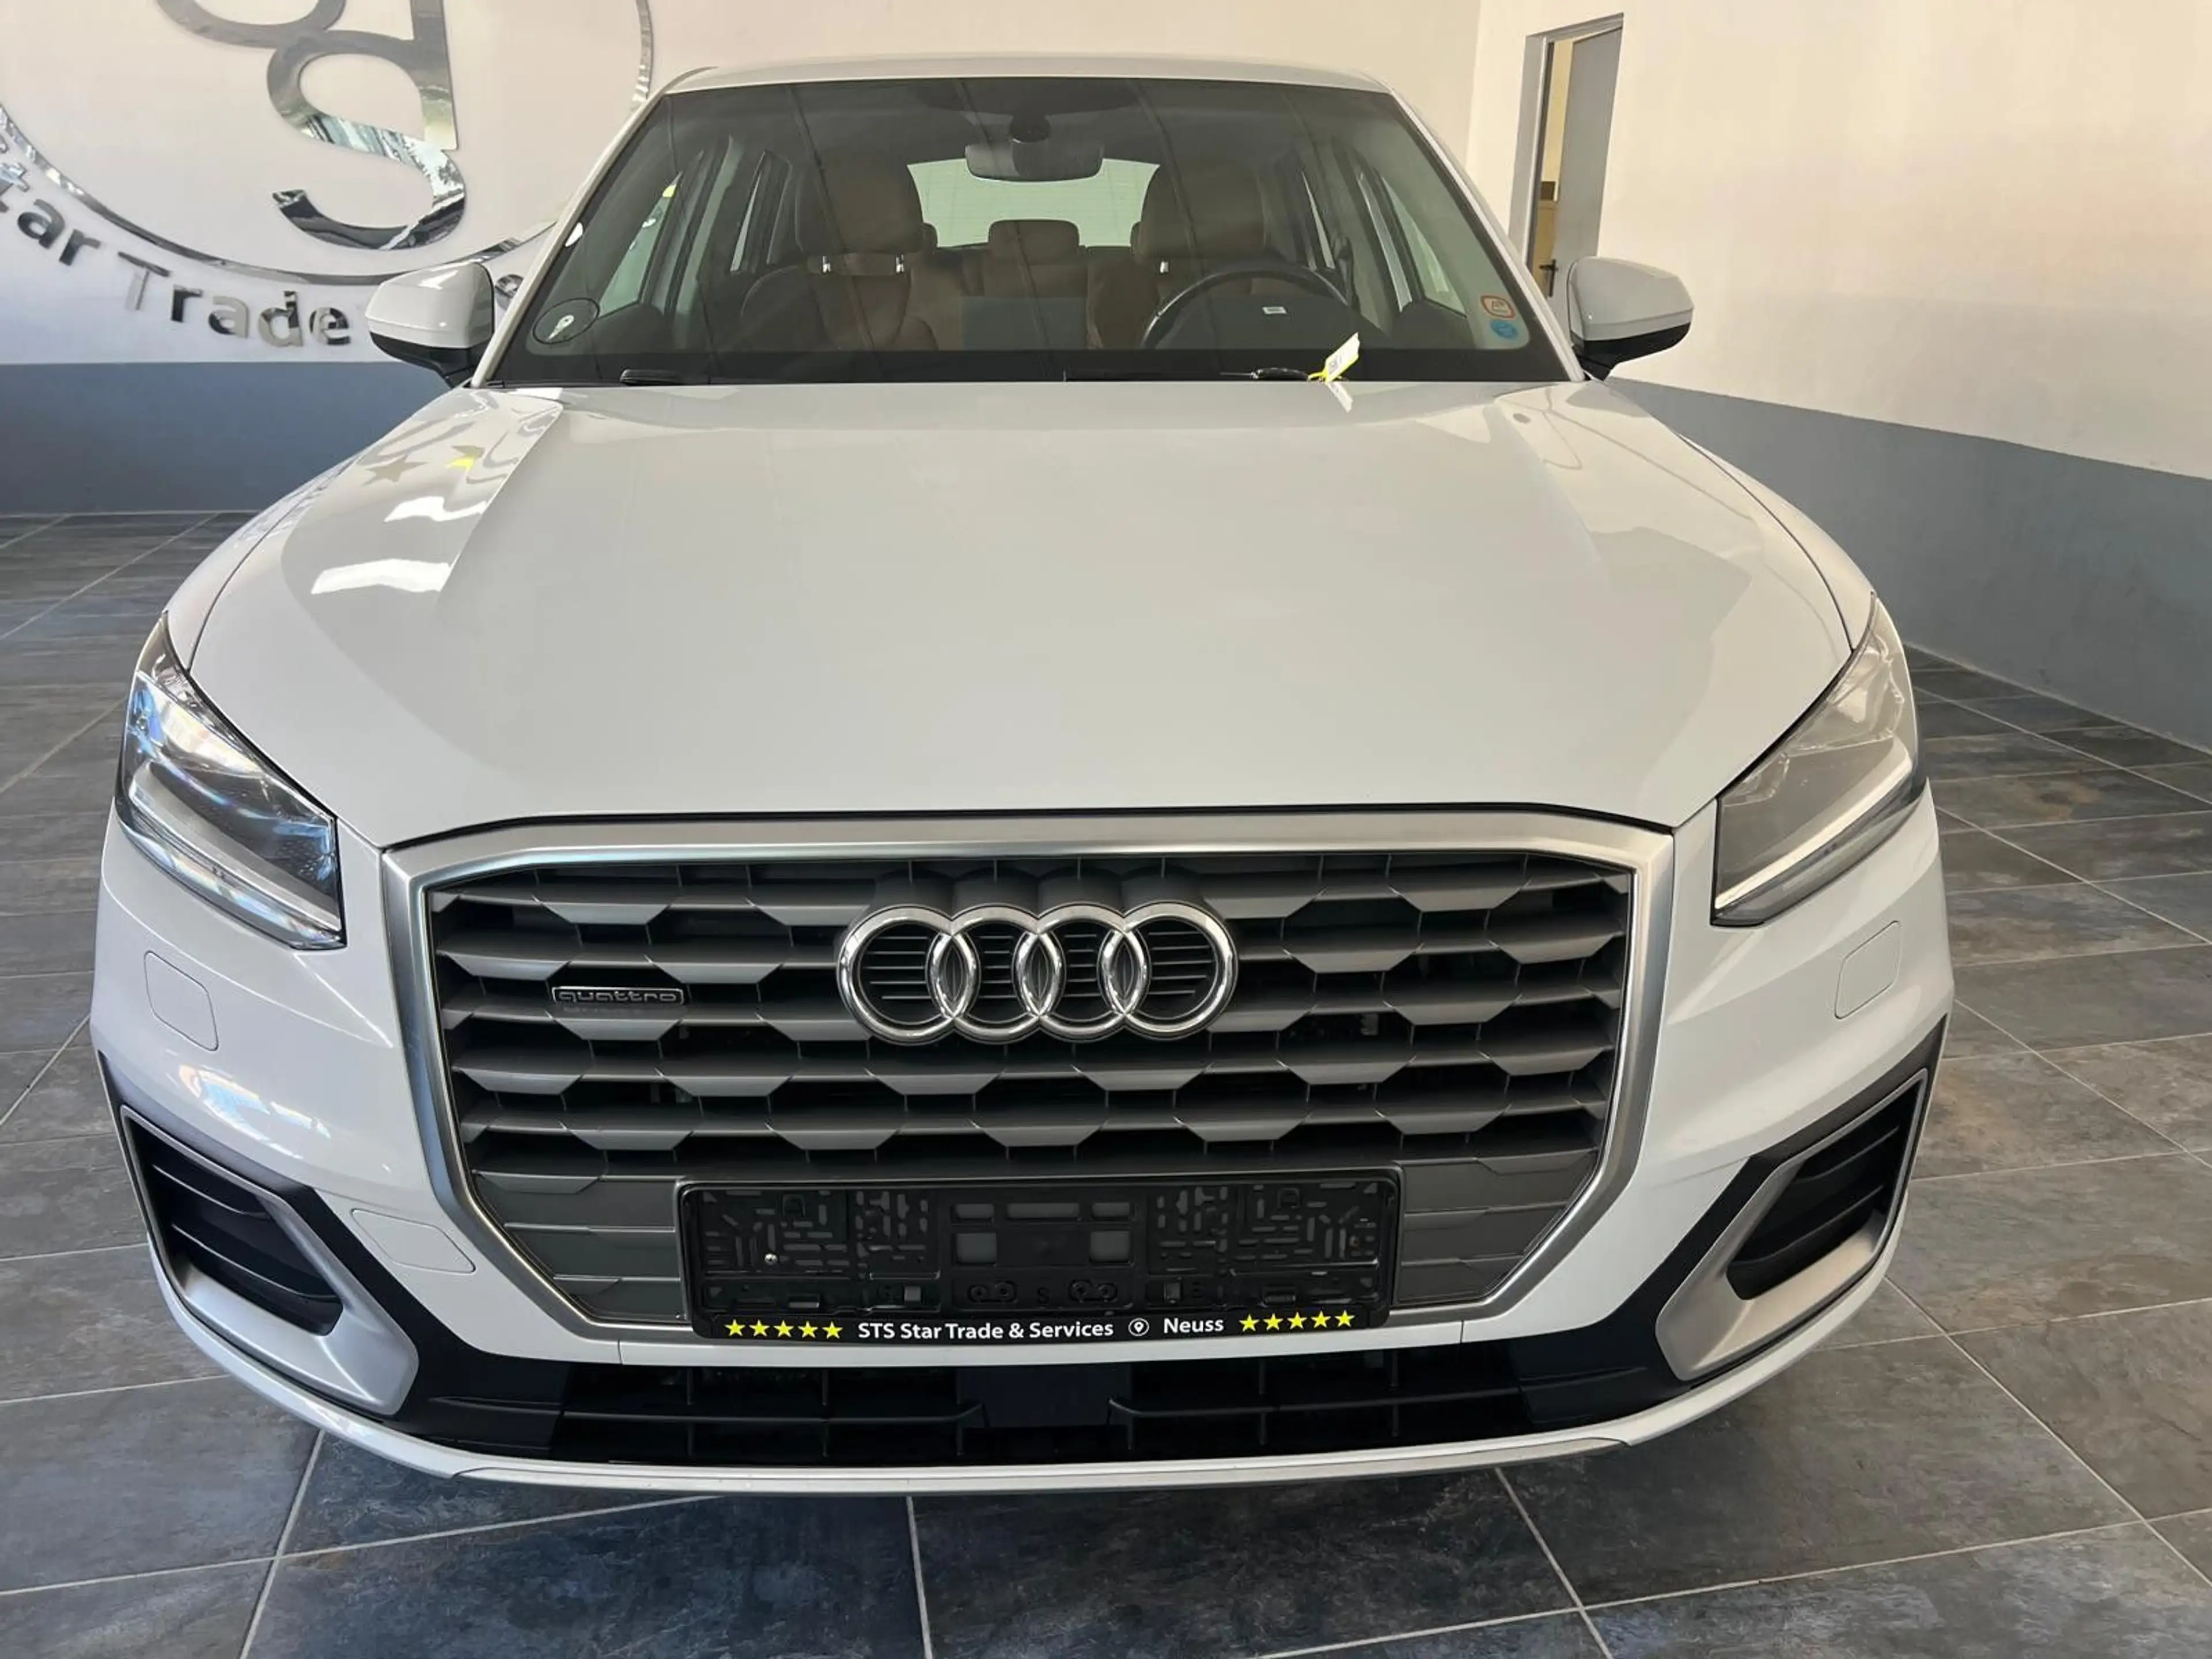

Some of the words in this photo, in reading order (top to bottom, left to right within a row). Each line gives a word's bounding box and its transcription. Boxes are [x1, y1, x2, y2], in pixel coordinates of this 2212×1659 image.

[0, 134, 101, 266] tar
[117, 251, 351, 347] Trade
[558, 991, 677, 1003] quattro
[858, 1323, 895, 1339] STS
[900, 1323, 942, 1339] Star
[945, 1323, 1003, 1339] Trade
[1008, 1323, 1024, 1338] &
[1029, 1321, 1114, 1338] Services
[1163, 1317, 1225, 1334] Neuss
